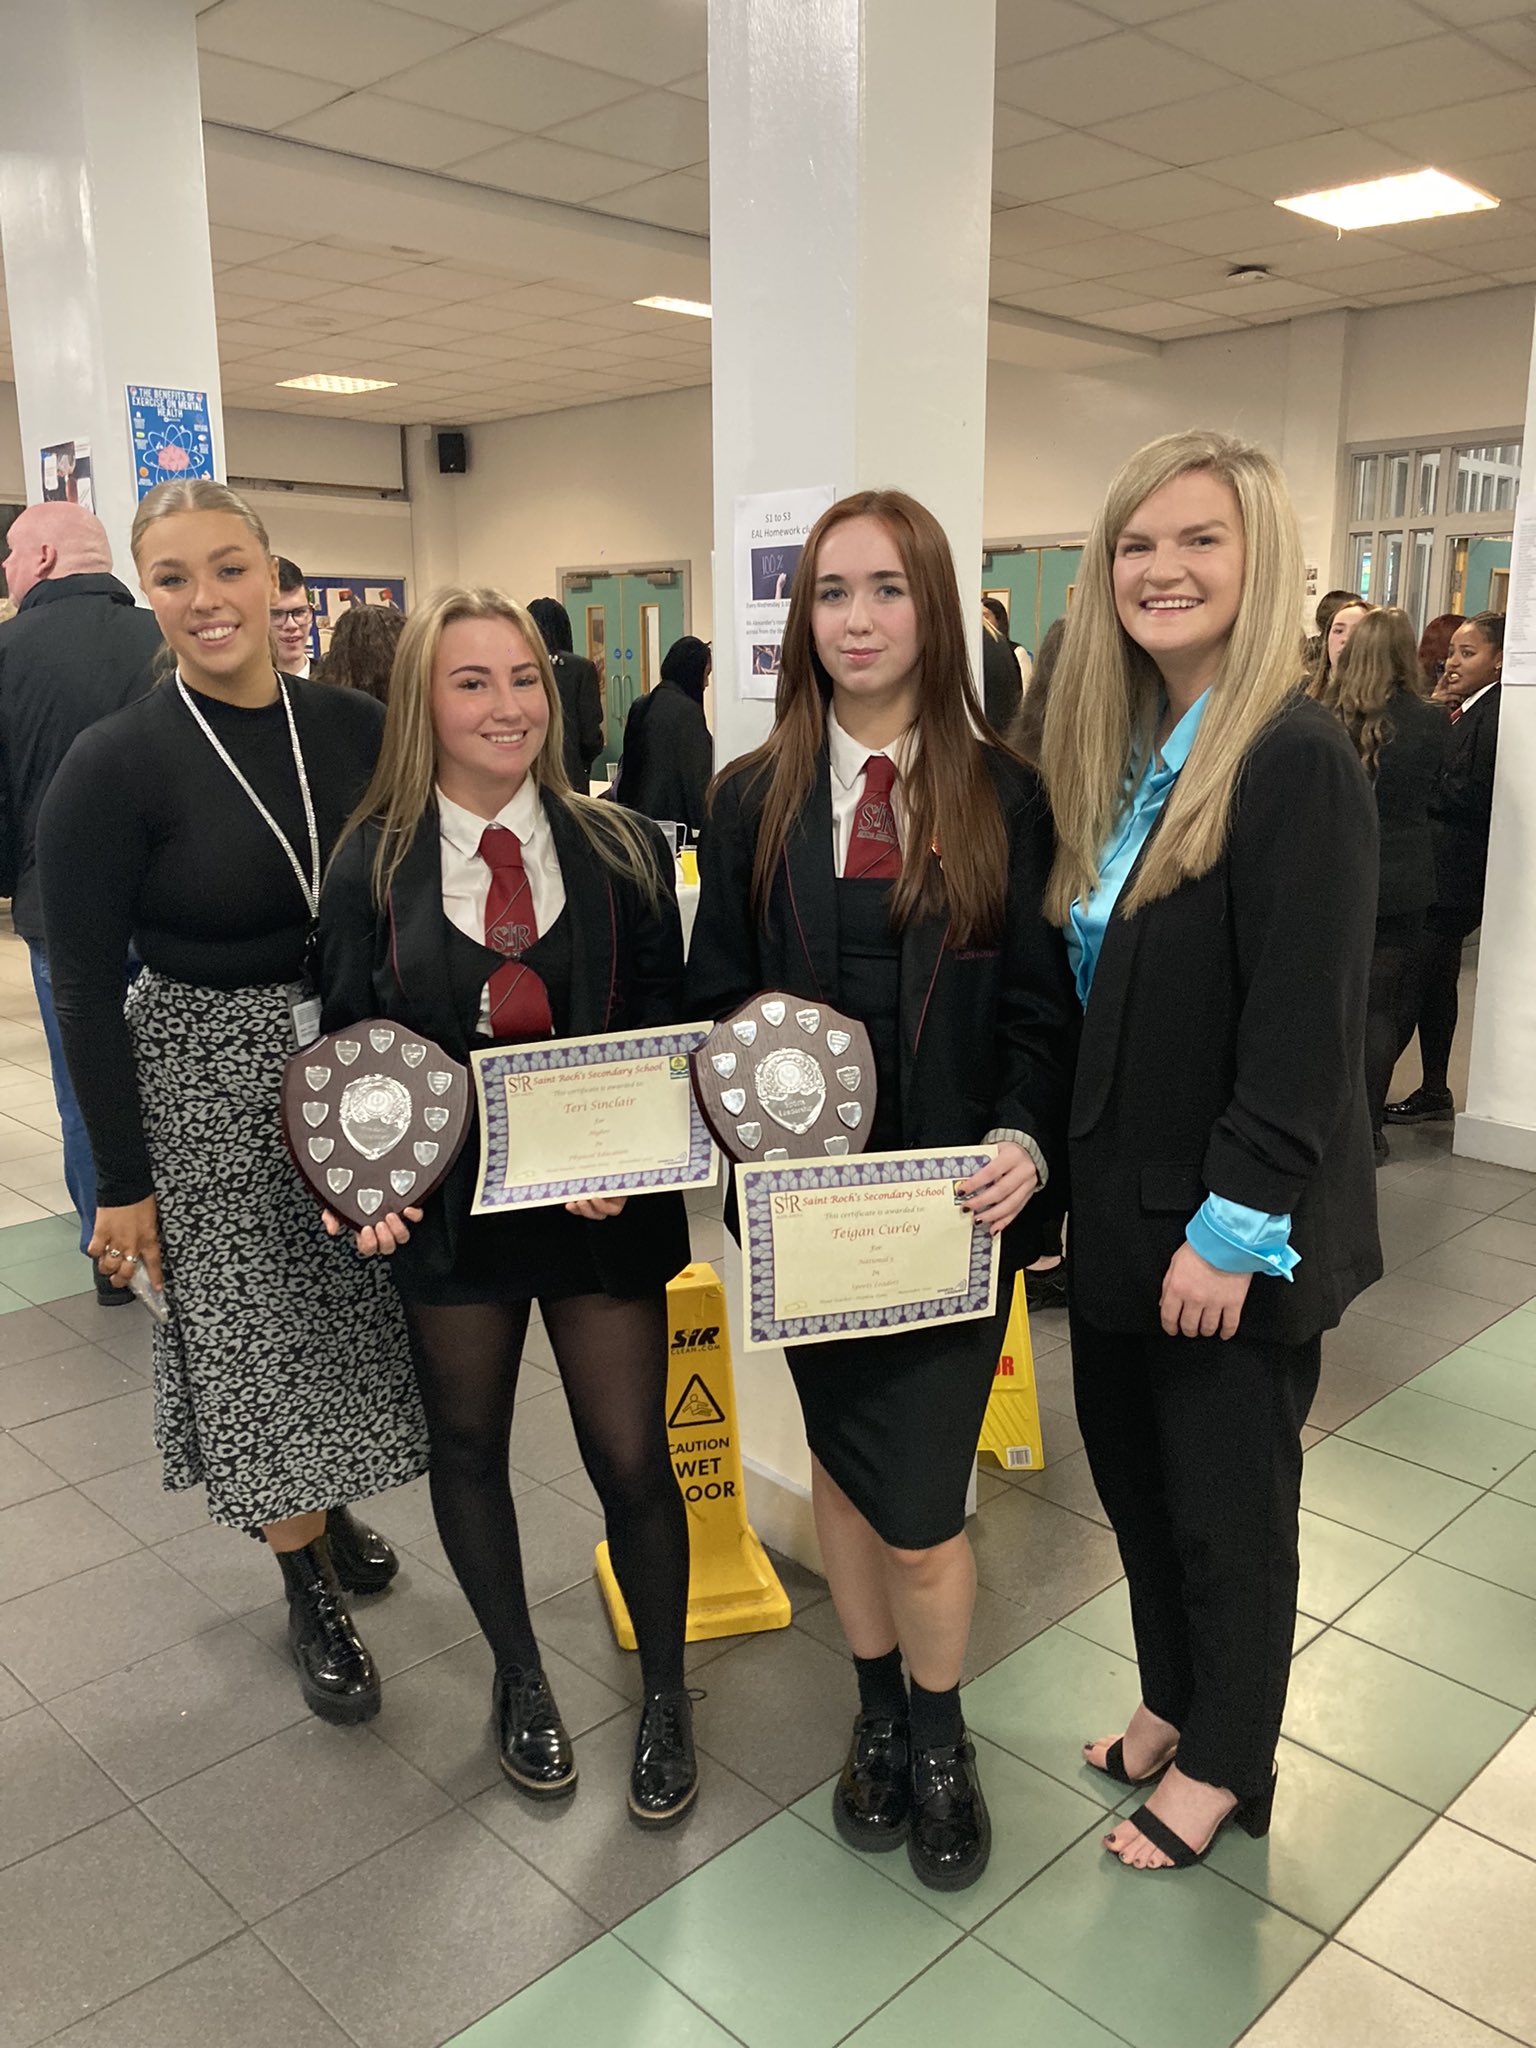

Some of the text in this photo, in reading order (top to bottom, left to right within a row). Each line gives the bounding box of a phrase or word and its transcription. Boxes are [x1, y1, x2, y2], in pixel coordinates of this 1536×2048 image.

[139, 388, 195, 401] THE BENEFITS OF
[132, 397, 203, 412] EXERCISE ON MENTAL
[157, 407, 183, 418] HEALTH
[765, 512, 791, 523] S1 to S3
[751, 529, 763, 539] EAL
[764, 526, 800, 538] Homework
[762, 554, 784, 575] 100%
[533, 1076, 556, 1086] Saint
[559, 1072, 586, 1083] Roch's
[587, 1067, 633, 1081] Secondary
[634, 1062, 664, 1074] School
[563, 1096, 637, 1114] Teri Sinclair
[802, 1196, 828, 1207] Saint
[831, 1192, 861, 1204] Roch's
[863, 1190, 913, 1202] Secondary
[915, 1186, 947, 1198] School
[825, 1212, 839, 1220] This
[840, 1208, 876, 1220] certificate
[884, 1206, 916, 1215] awarded
[832, 1221, 921, 1241] Teigan Curley
[670, 1344, 720, 1355] CLEAN.COM
[668, 1437, 729, 1455] CAUTION
[675, 1457, 722, 1478] WET
[685, 1480, 736, 1502] OOR
